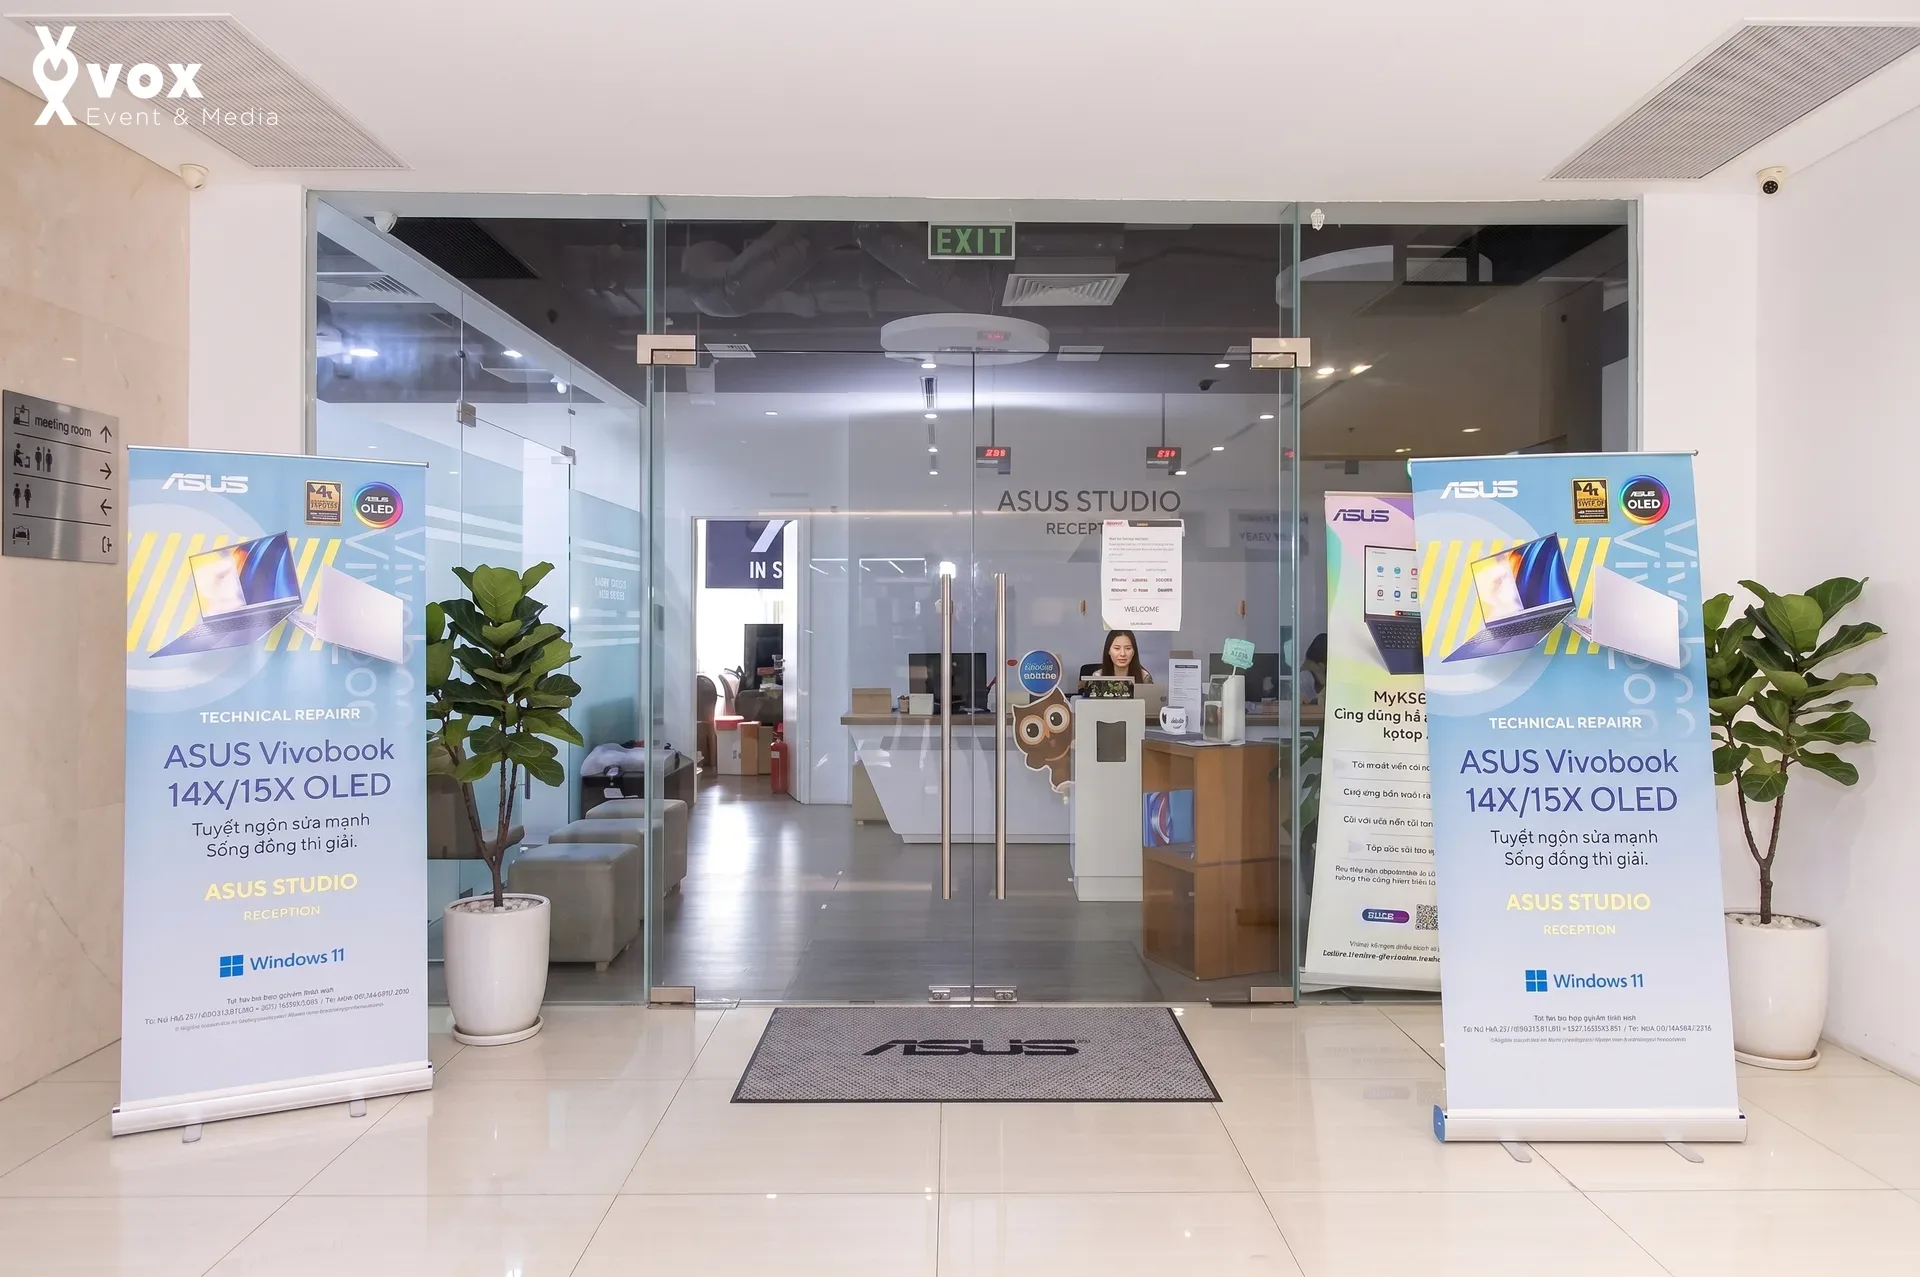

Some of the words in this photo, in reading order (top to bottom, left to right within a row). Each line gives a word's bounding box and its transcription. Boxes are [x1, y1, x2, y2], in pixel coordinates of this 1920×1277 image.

[937, 228, 1006, 254] EXIT
[34, 415, 69, 435] meeting
[71, 424, 92, 437] room
[161, 472, 248, 494] ASUS
[1440, 479, 1518, 500] ASUS
[360, 503, 394, 514] OLED
[997, 490, 1069, 513] ASUS
[1076, 489, 1181, 513] STUDIO
[1627, 499, 1661, 510] OLED
[1333, 508, 1389, 523] ASUS
[749, 560, 766, 579] IN
[200, 709, 291, 724] TECHNICAL
[295, 707, 361, 721] REPAIRR
[1489, 717, 1574, 730] TECHNICAL
[1577, 716, 1642, 729] REPAIRR
[164, 741, 251, 769] ASUS
[259, 738, 395, 765] Vivobook
[1460, 749, 1540, 775] ASUS
[1545, 748, 1679, 774] Vivobook
[168, 776, 295, 810] 14X/15X
[303, 772, 391, 800] OLED
[1465, 786, 1584, 818] 14X/15X
[1590, 786, 1678, 812] OLED
[325, 813, 370, 830] mạnh
[1614, 829, 1658, 847] mạnh
[204, 878, 267, 901] ASUS
[272, 873, 358, 896] STUDIO
[1506, 893, 1563, 911] ASUS
[1568, 892, 1651, 911] STUDIO
[243, 904, 321, 921] RECEPTION
[1543, 924, 1617, 936] RECEPTION
[250, 949, 328, 971] Windows
[331, 947, 345, 962] 11
[1553, 973, 1628, 988] Windows
[1631, 973, 1644, 988] 11
[862, 1039, 1080, 1056] ASUS
